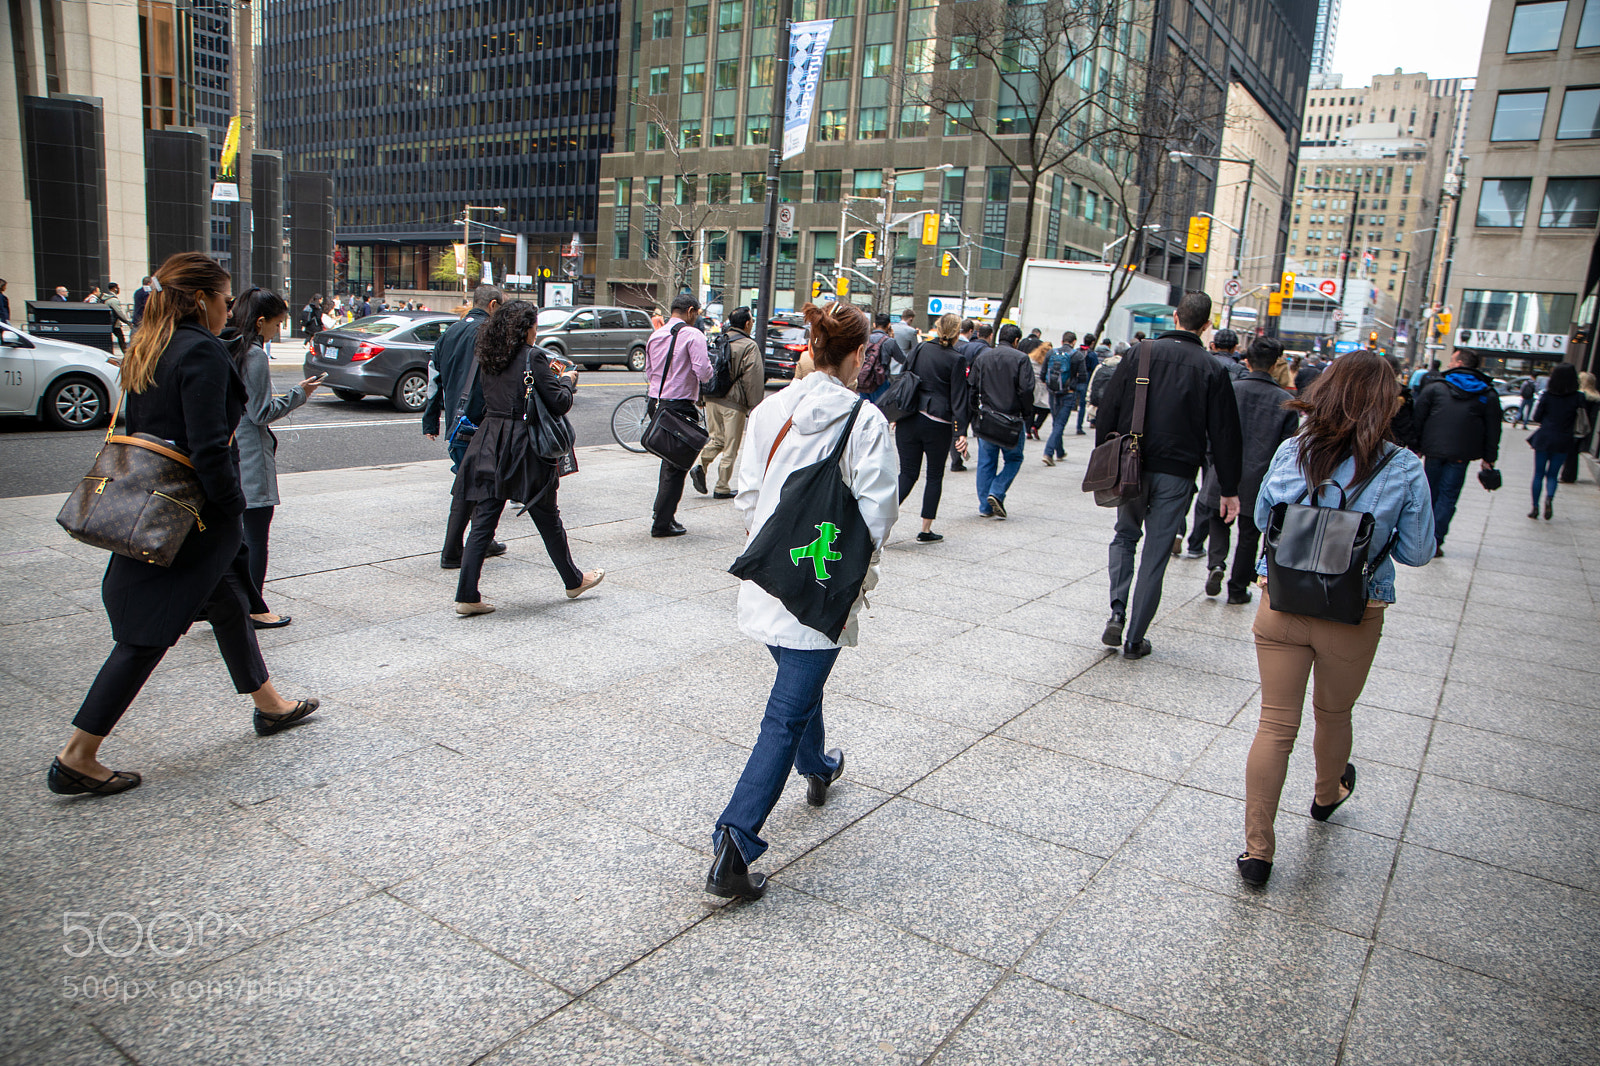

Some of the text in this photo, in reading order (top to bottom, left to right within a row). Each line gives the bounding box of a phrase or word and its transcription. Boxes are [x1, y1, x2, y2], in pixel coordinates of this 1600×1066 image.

[799, 27, 830, 120] OPPORTUNITY
[1476, 331, 1563, 349] WALRUS
[4, 370, 23, 386] 713
